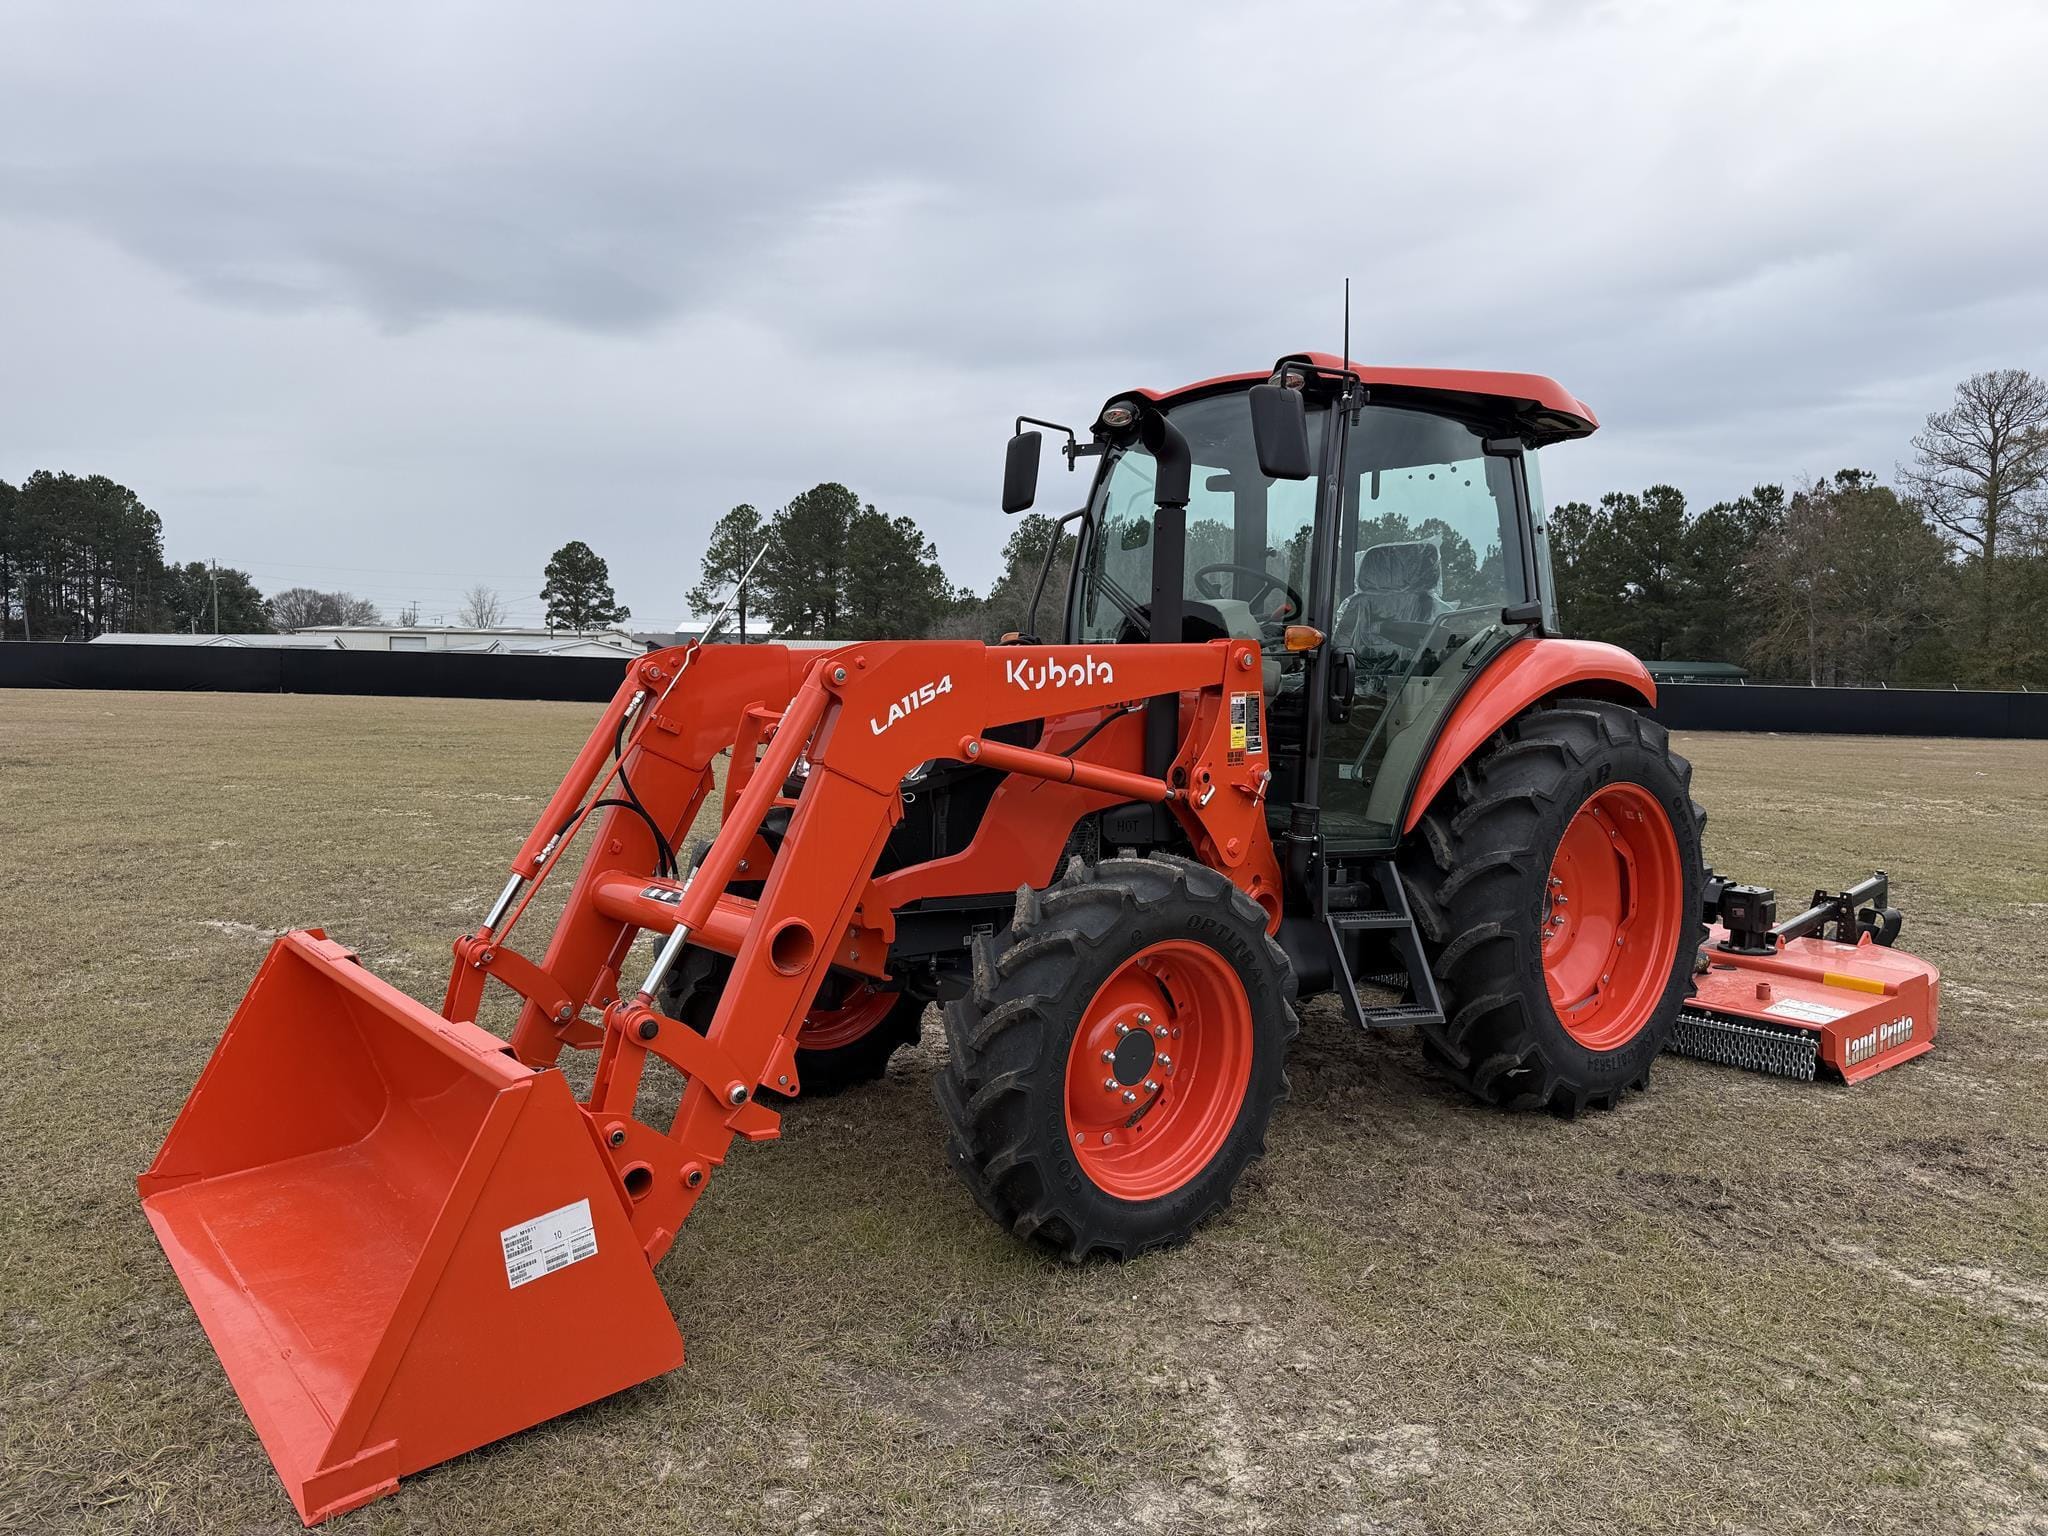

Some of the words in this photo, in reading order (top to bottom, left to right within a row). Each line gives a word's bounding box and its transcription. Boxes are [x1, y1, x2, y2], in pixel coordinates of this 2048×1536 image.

[1006, 654, 1113, 691] Kubota
[870, 674, 953, 736] LA1154
[1117, 819, 1140, 833] HOT
[1187, 914, 1270, 998] OPTITRAC
[1844, 1029, 1877, 1069] Land
[1878, 1015, 1914, 1055] Pride
[553, 1230, 563, 1240] 10
